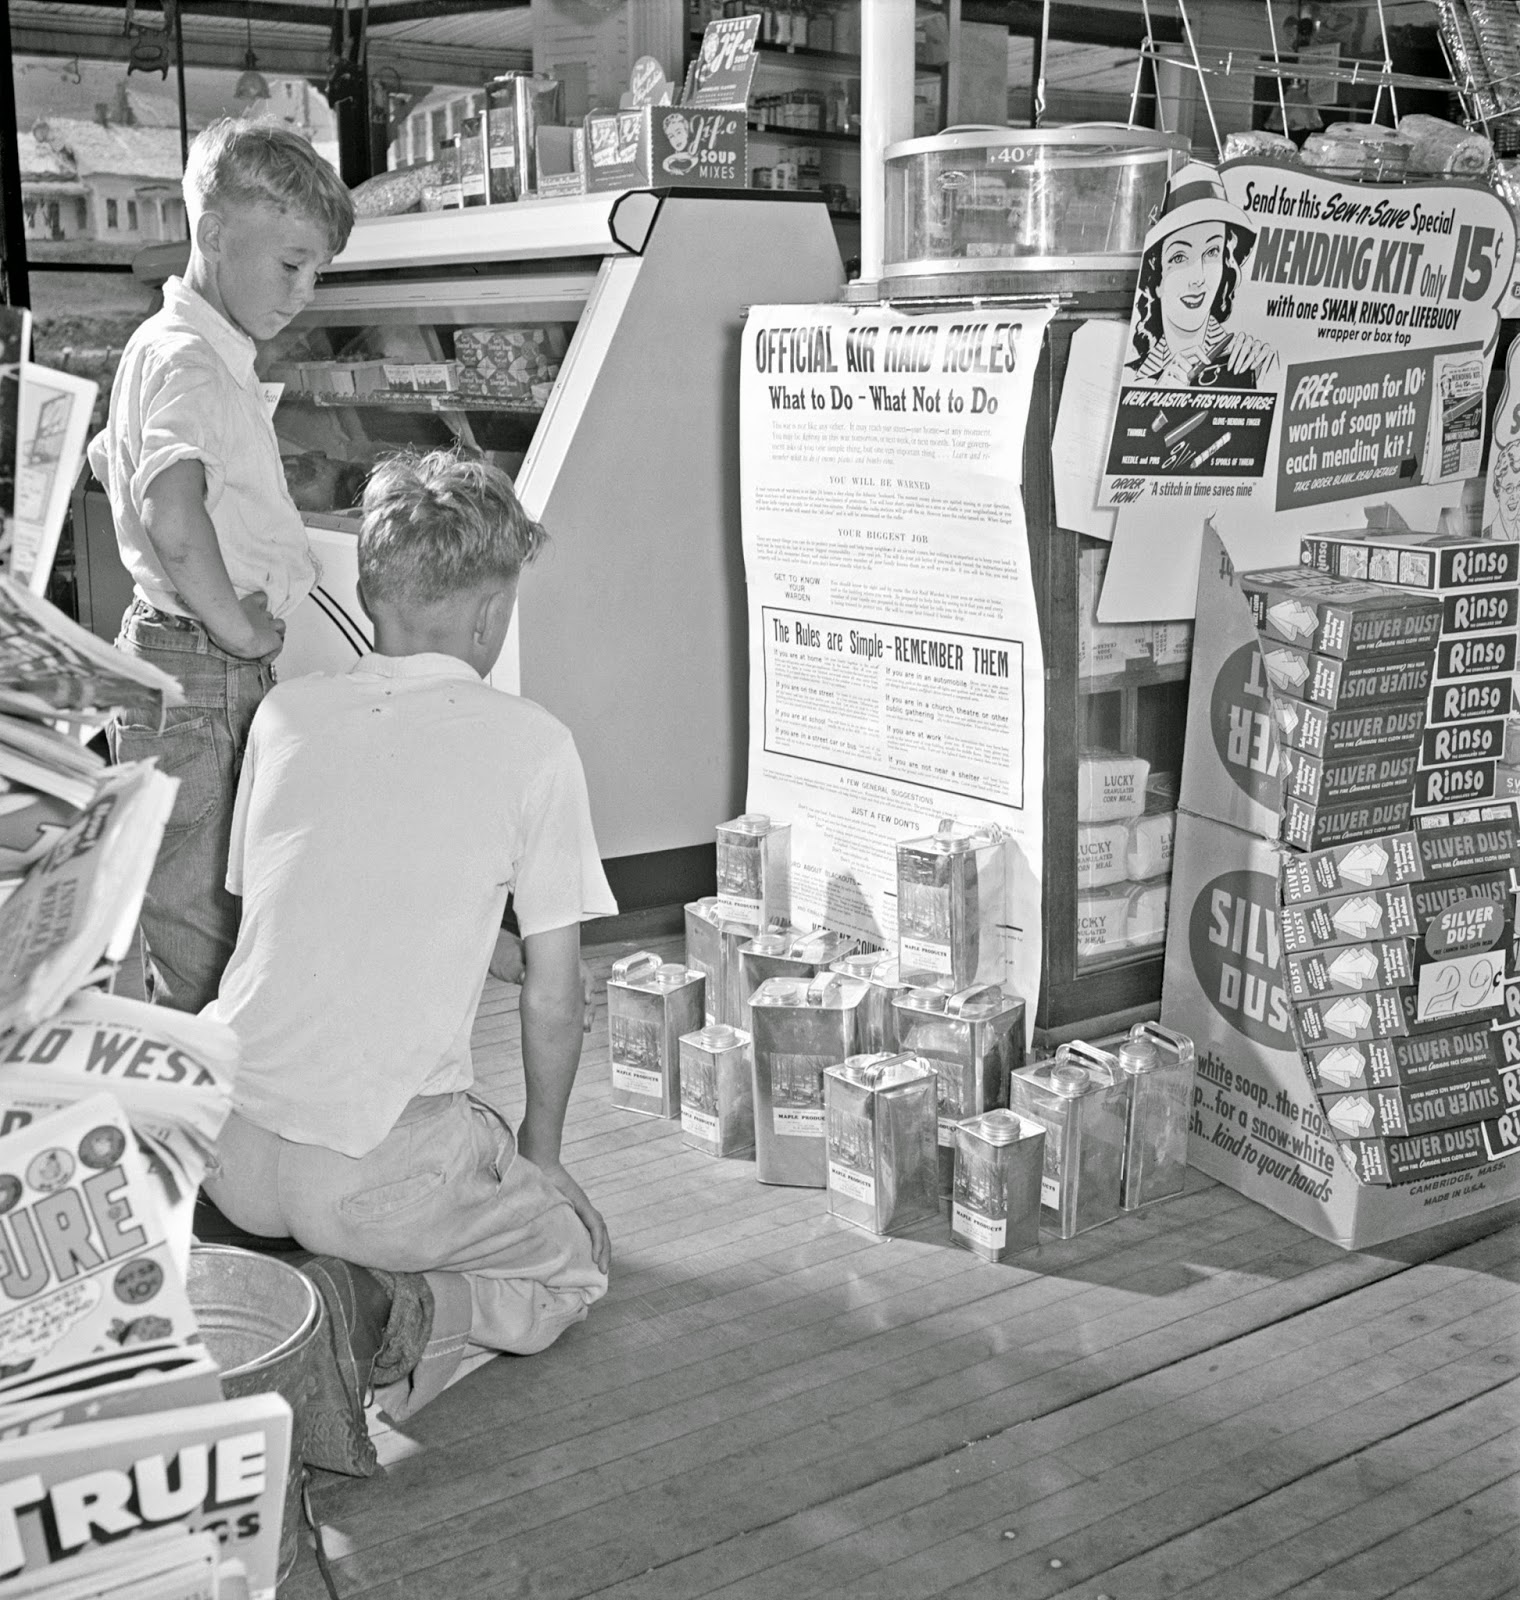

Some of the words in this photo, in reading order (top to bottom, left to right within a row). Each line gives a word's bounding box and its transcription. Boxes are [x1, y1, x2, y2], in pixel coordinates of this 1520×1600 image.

[716, 20, 752, 32] TETLEY
[701, 150, 736, 163] SOUP
[701, 166, 735, 179] MIXES
[1244, 181, 1278, 215] Send
[1278, 187, 1297, 216] for
[1299, 189, 1321, 219] this
[1411, 204, 1455, 235] Special
[1251, 227, 1374, 291] MENDING
[1372, 240, 1424, 295] KIT
[1420, 264, 1447, 304] Only
[1267, 295, 1294, 318] with
[1297, 301, 1318, 319] one
[1321, 298, 1356, 327] SWAN,
[1359, 300, 1393, 325] RINSO
[1395, 309, 1409, 326] or
[1409, 306, 1461, 330] LIFEBUOY
[756, 326, 838, 373] OFFICIAL
[846, 327, 879, 373] AIR
[884, 325, 938, 373] RAID
[942, 323, 1023, 373] RULES
[1318, 326, 1358, 342] wrapper
[1360, 330, 1372, 340] or
[1374, 328, 1391, 343] box
[1394, 330, 1411, 346] top
[769, 385, 806, 411] What
[811, 387, 825, 410] to
[830, 385, 853, 410] Do
[869, 385, 906, 412] What
[913, 386, 940, 413] Not
[948, 387, 964, 413] to
[970, 387, 998, 414] Do
[1214, 394, 1240, 408] YOUR
[1240, 396, 1274, 410] PURSE
[1291, 372, 1338, 411] FREE
[1332, 383, 1378, 409] coupon
[1382, 374, 1401, 398] for
[1289, 414, 1329, 443] worth
[1331, 411, 1346, 437] of
[1349, 415, 1381, 435] soap
[1385, 402, 1416, 429] with
[1122, 456, 1138, 464] NEEDLE
[1150, 456, 1160, 465] PINS
[1215, 458, 1231, 466] SPOOLS
[1286, 446, 1317, 475] each
[1322, 440, 1379, 467] mending
[830, 476, 847, 485] YOU
[852, 478, 875, 486] WILL
[880, 479, 892, 487] BE
[897, 479, 930, 490] WARNED
[1111, 478, 1145, 489] ORDER
[1159, 482, 1183, 496] stitch
[1184, 483, 1192, 496] in
[1194, 482, 1210, 496] time
[1212, 487, 1234, 496] saves
[1294, 480, 1311, 492] TAKE
[1311, 476, 1333, 489] ORDER
[1373, 465, 1398, 478] DETAILS
[1110, 487, 1144, 503] NOW!
[838, 529, 861, 538] YOUR
[867, 530, 906, 541] BIGGEST
[911, 534, 928, 543] JOB
[774, 573, 786, 582] GET
[788, 574, 798, 583] TO
[800, 576, 820, 585] KNOW
[1451, 551, 1508, 583] Rinso
[785, 592, 810, 602] WARDEN
[789, 583, 805, 592] YOUR
[1454, 596, 1508, 629] Rinso
[1353, 618, 1401, 642] SILVER
[1404, 613, 1440, 635] DUST
[773, 618, 789, 644] The
[796, 622, 820, 648] Rules
[827, 631, 842, 652] are
[850, 630, 883, 661] Simple
[895, 636, 963, 671] REMEMBER
[973, 647, 1009, 678] THEM
[1449, 641, 1505, 674] Rinso
[1340, 676, 1377, 699] DUST
[1380, 670, 1428, 694] SILVER
[905, 708, 934, 720] gathering
[1444, 686, 1501, 718] Rinso
[957, 707, 979, 717] theatre
[991, 714, 1008, 722] other
[1330, 716, 1383, 741] SILVER
[1386, 712, 1424, 731] DUST
[1435, 727, 1493, 760] Rinso
[1104, 775, 1134, 787] LUCKY
[1325, 761, 1376, 788] SILVER
[1379, 757, 1416, 779] DUST
[1104, 787, 1134, 795] GRANULATED
[1428, 769, 1484, 802] Rinso
[851, 807, 869, 816] JUST
[870, 811, 875, 819] A
[878, 812, 892, 823] FEW
[1317, 807, 1368, 835] SILVER
[1371, 803, 1410, 825] DUST
[1421, 836, 1473, 861] SILVER
[1476, 829, 1513, 852] DUST
[1441, 906, 1494, 930] SILVER
[1446, 924, 1486, 945] DUST
[1219, 962, 1288, 1032] DUS
[1400, 1037, 1451, 1066] SILVER
[1453, 1031, 1489, 1055] DUST
[617, 1069, 631, 1077] MAPLE
[634, 1073, 659, 1082] PRODUCTS
[1198, 1051, 1232, 1087] white
[1301, 1103, 1328, 1137] rig
[1239, 1110, 1247, 1128] a
[1390, 1132, 1442, 1164] SILVER
[1445, 1127, 1481, 1150] DUST
[1241, 1142, 1258, 1164] to
[1257, 1154, 1292, 1181] your
[1287, 1164, 1332, 1202] hands
[1478, 1163, 1506, 1176] MASS.
[1424, 1193, 1450, 1206] MADE
[1452, 1190, 1461, 1198] IN
[957, 1211, 971, 1222] MAPLE
[973, 1219, 1002, 1232] PRODUCTS
[0, 1430, 266, 1577] TRUE
